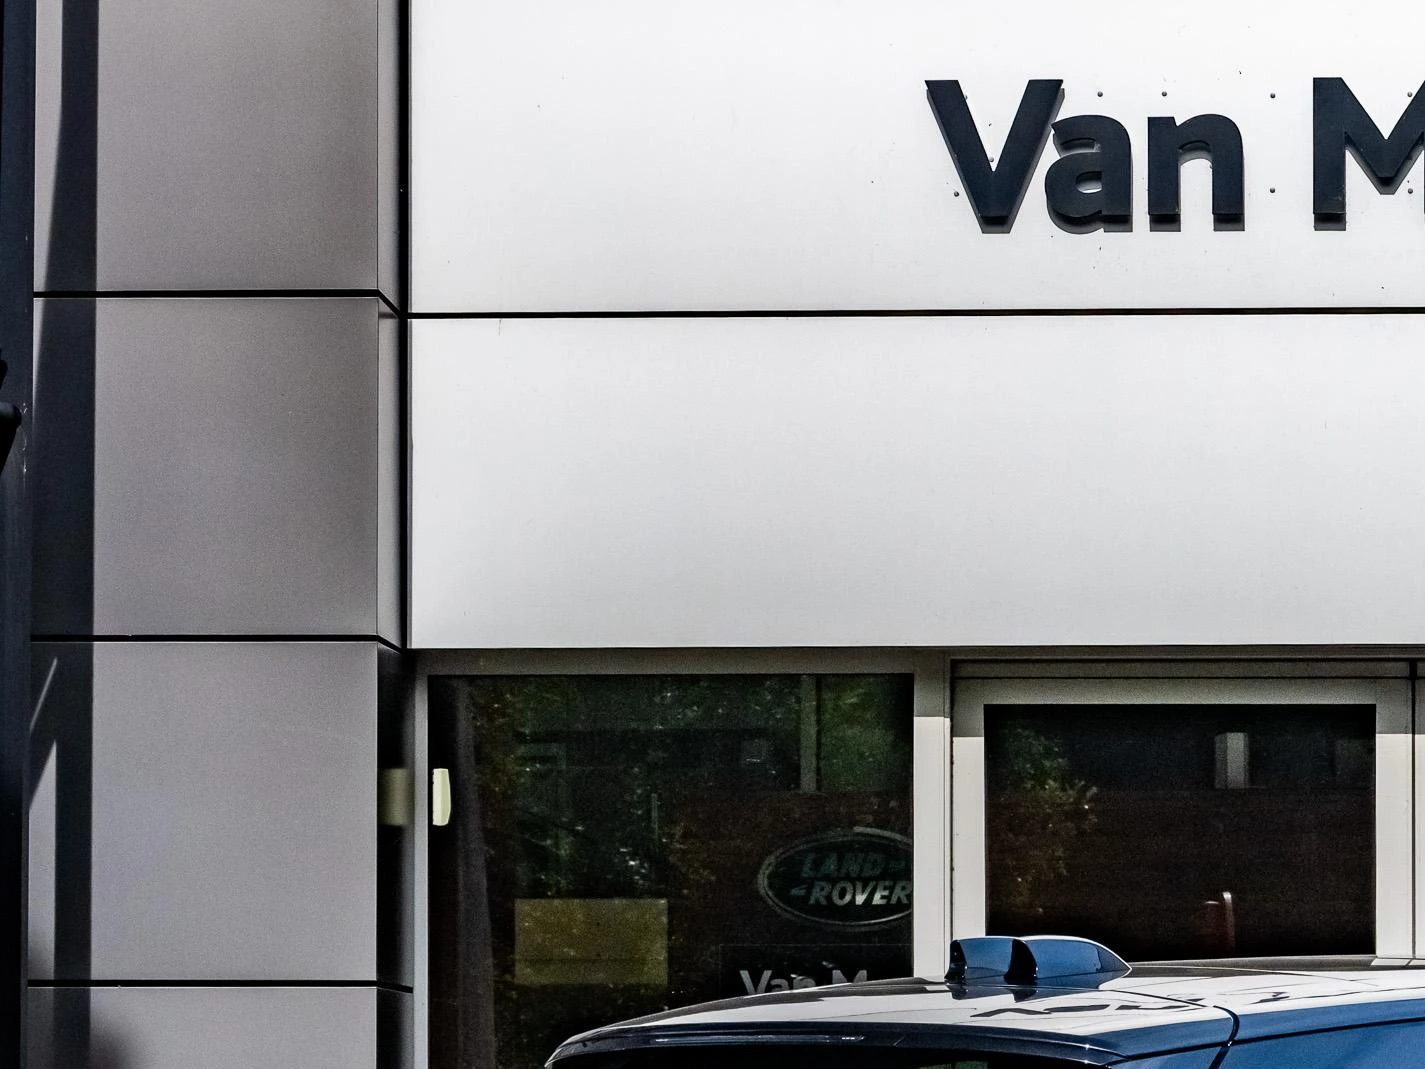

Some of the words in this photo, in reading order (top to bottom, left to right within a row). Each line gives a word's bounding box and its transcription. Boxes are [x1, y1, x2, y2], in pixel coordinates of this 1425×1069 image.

[925, 78, 1245, 234] Van
[800, 851, 885, 879] LAND
[809, 880, 912, 907] ROVER
